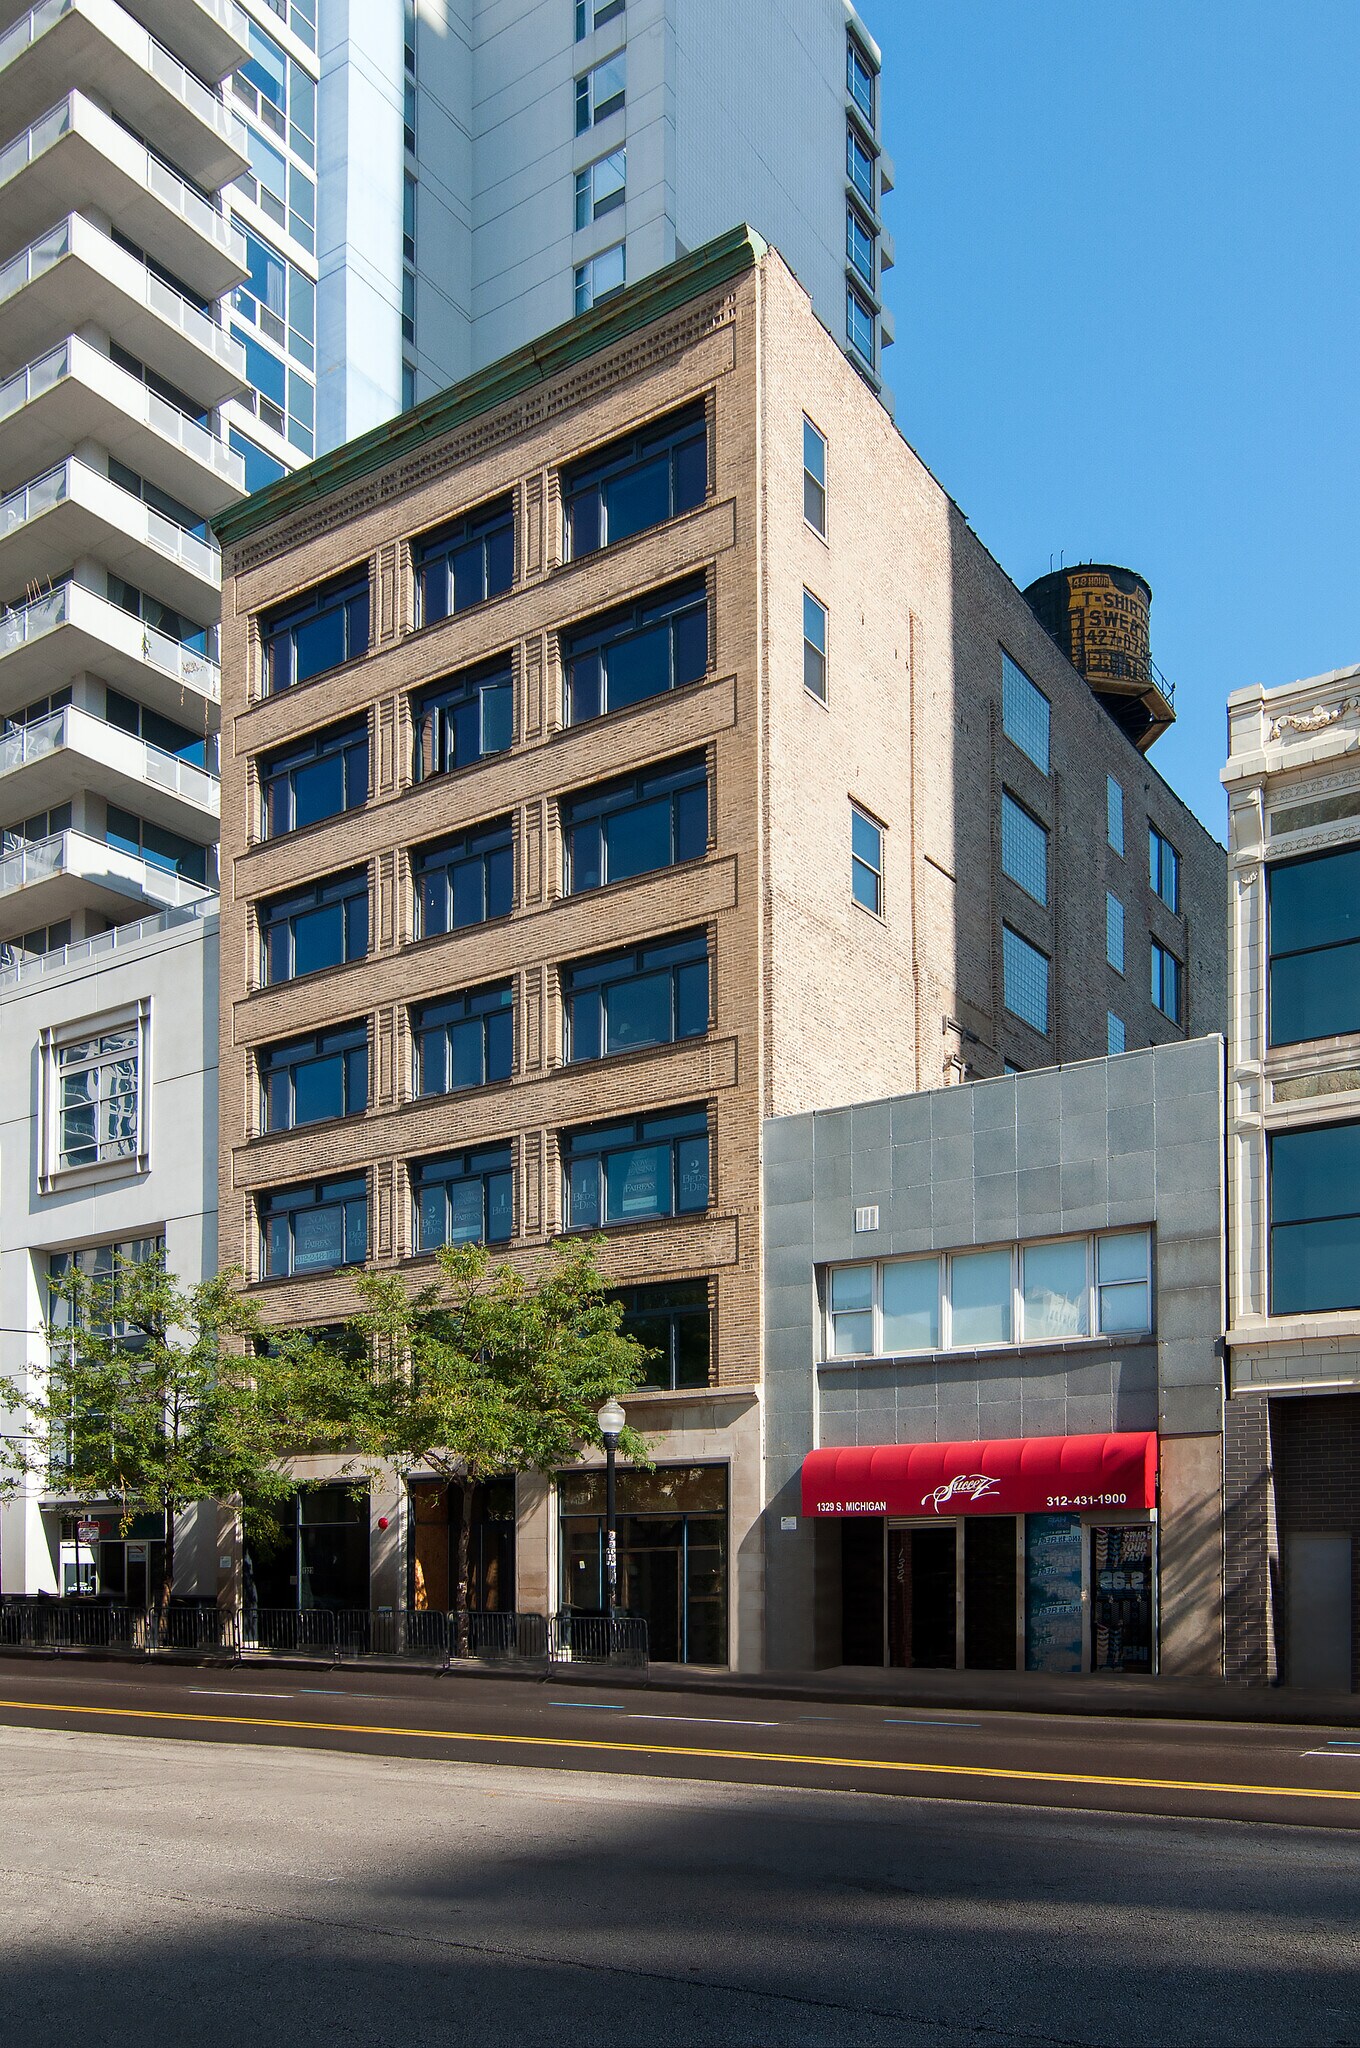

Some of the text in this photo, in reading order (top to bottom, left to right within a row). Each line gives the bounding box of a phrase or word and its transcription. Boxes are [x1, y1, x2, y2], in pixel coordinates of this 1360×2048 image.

[1088, 576, 1109, 586] HOUR
[690, 1160, 699, 1174] 2
[582, 1179, 586, 1192] 1
[501, 1193, 505, 1206] 1
[429, 1206, 436, 1218] 2
[357, 1219, 361, 1231] 1
[1046, 1493, 1127, 1506] 312-431-1900
[816, 1501, 886, 1512] 1329 S. MICHIGAN
[1100, 1571, 1144, 1590] 26.2
